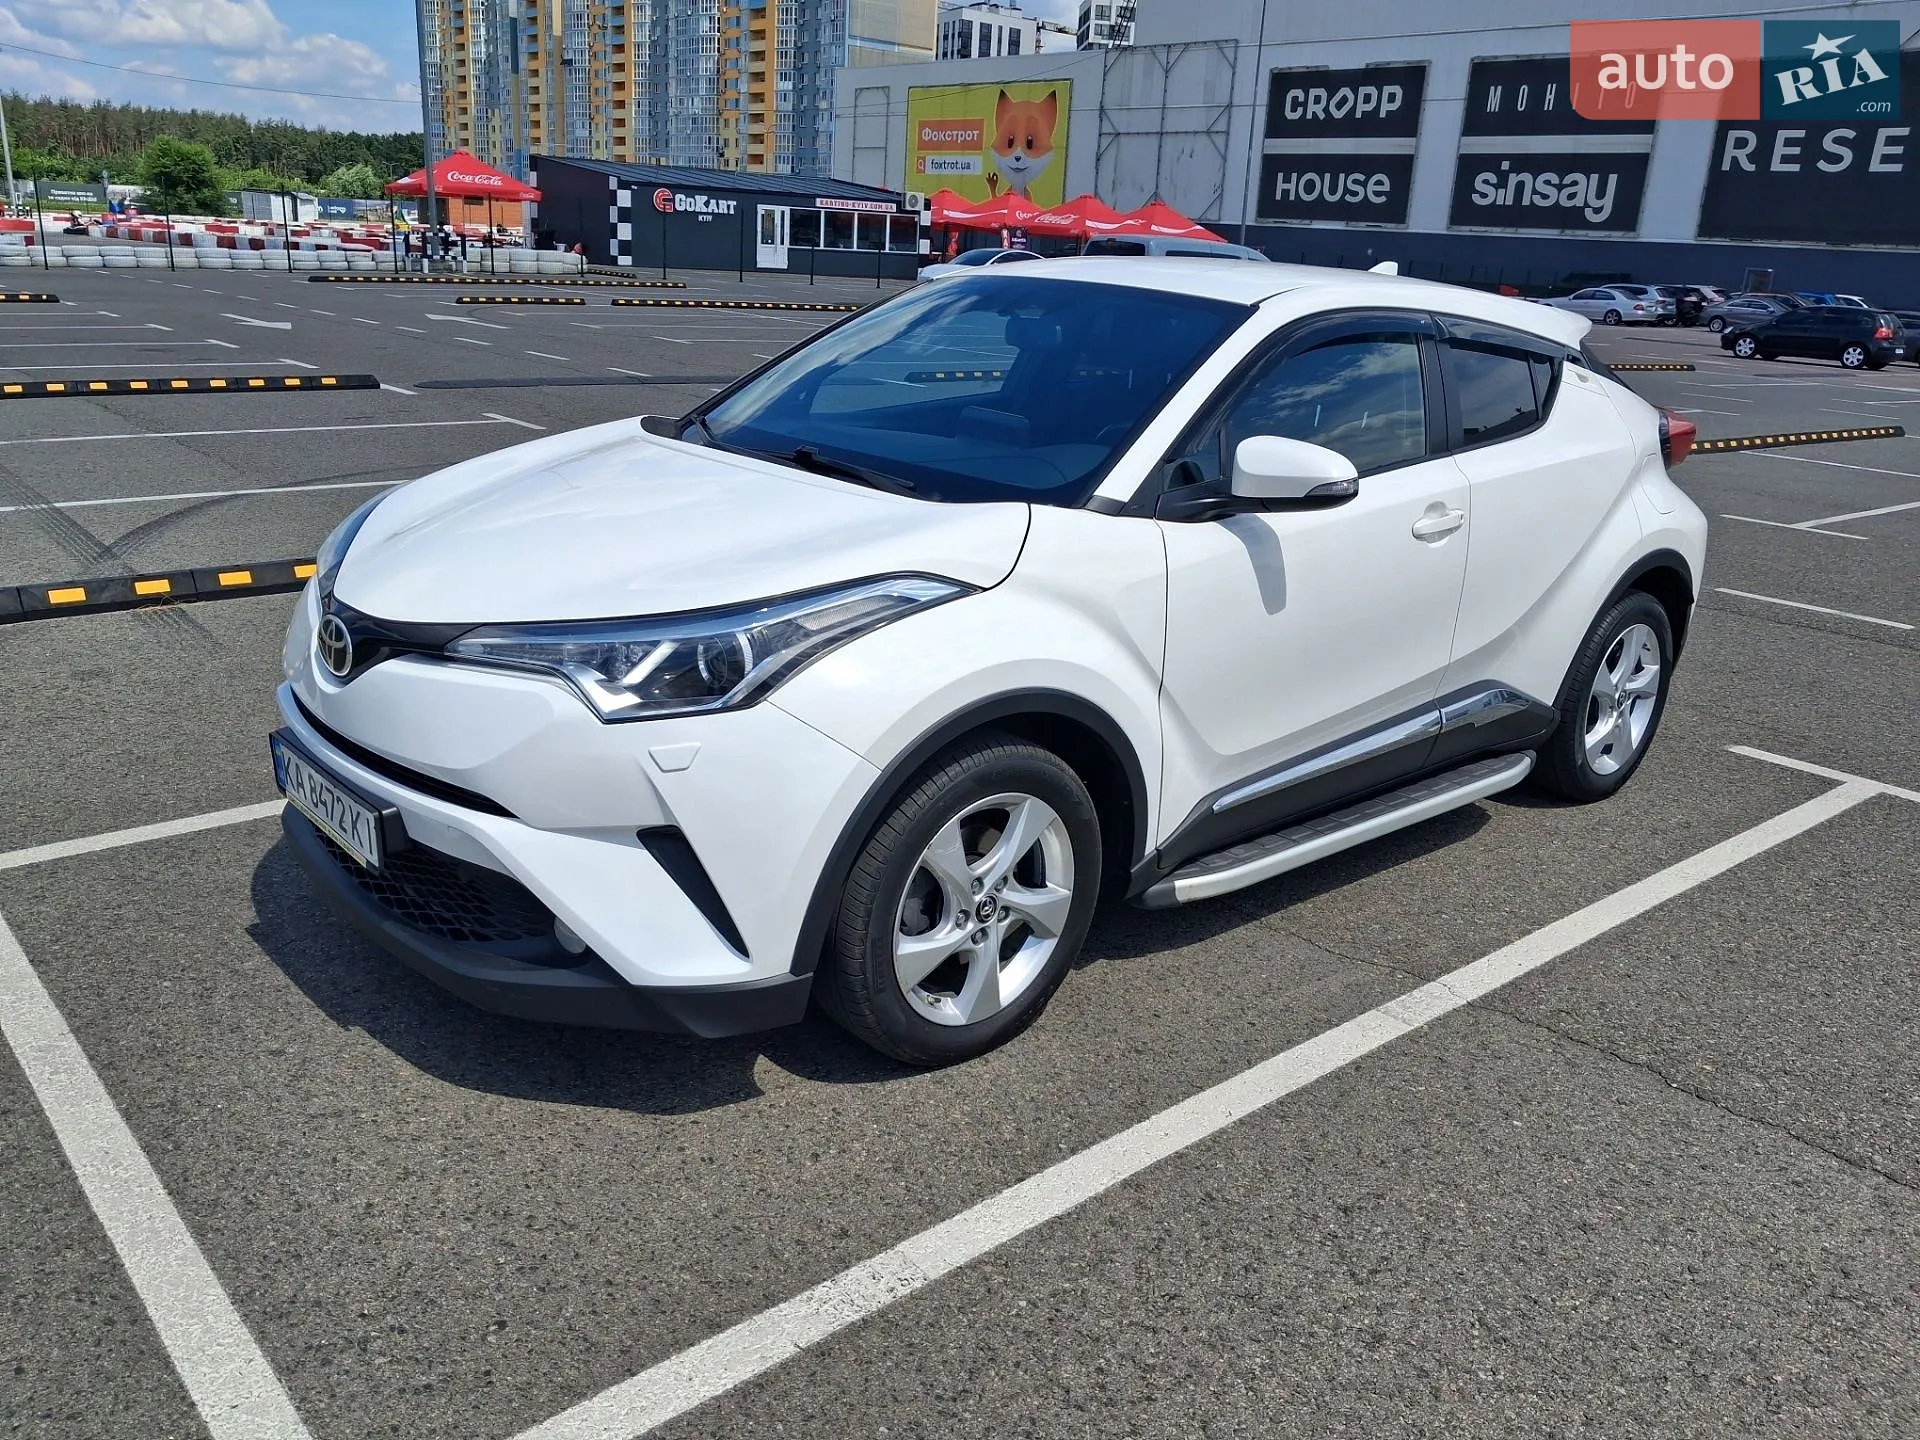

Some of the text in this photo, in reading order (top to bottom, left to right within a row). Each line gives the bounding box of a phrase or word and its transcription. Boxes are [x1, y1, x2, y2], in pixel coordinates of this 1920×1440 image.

[1284, 85, 1403, 120] CROPP
[921, 127, 979, 143] Фокстрот
[1721, 127, 1911, 173] RESE
[447, 171, 504, 186] Coca-Cola
[931, 159, 971, 170] foxtrot.ua
[1471, 160, 1619, 223] sinsay
[308, 772, 347, 834] 8472
